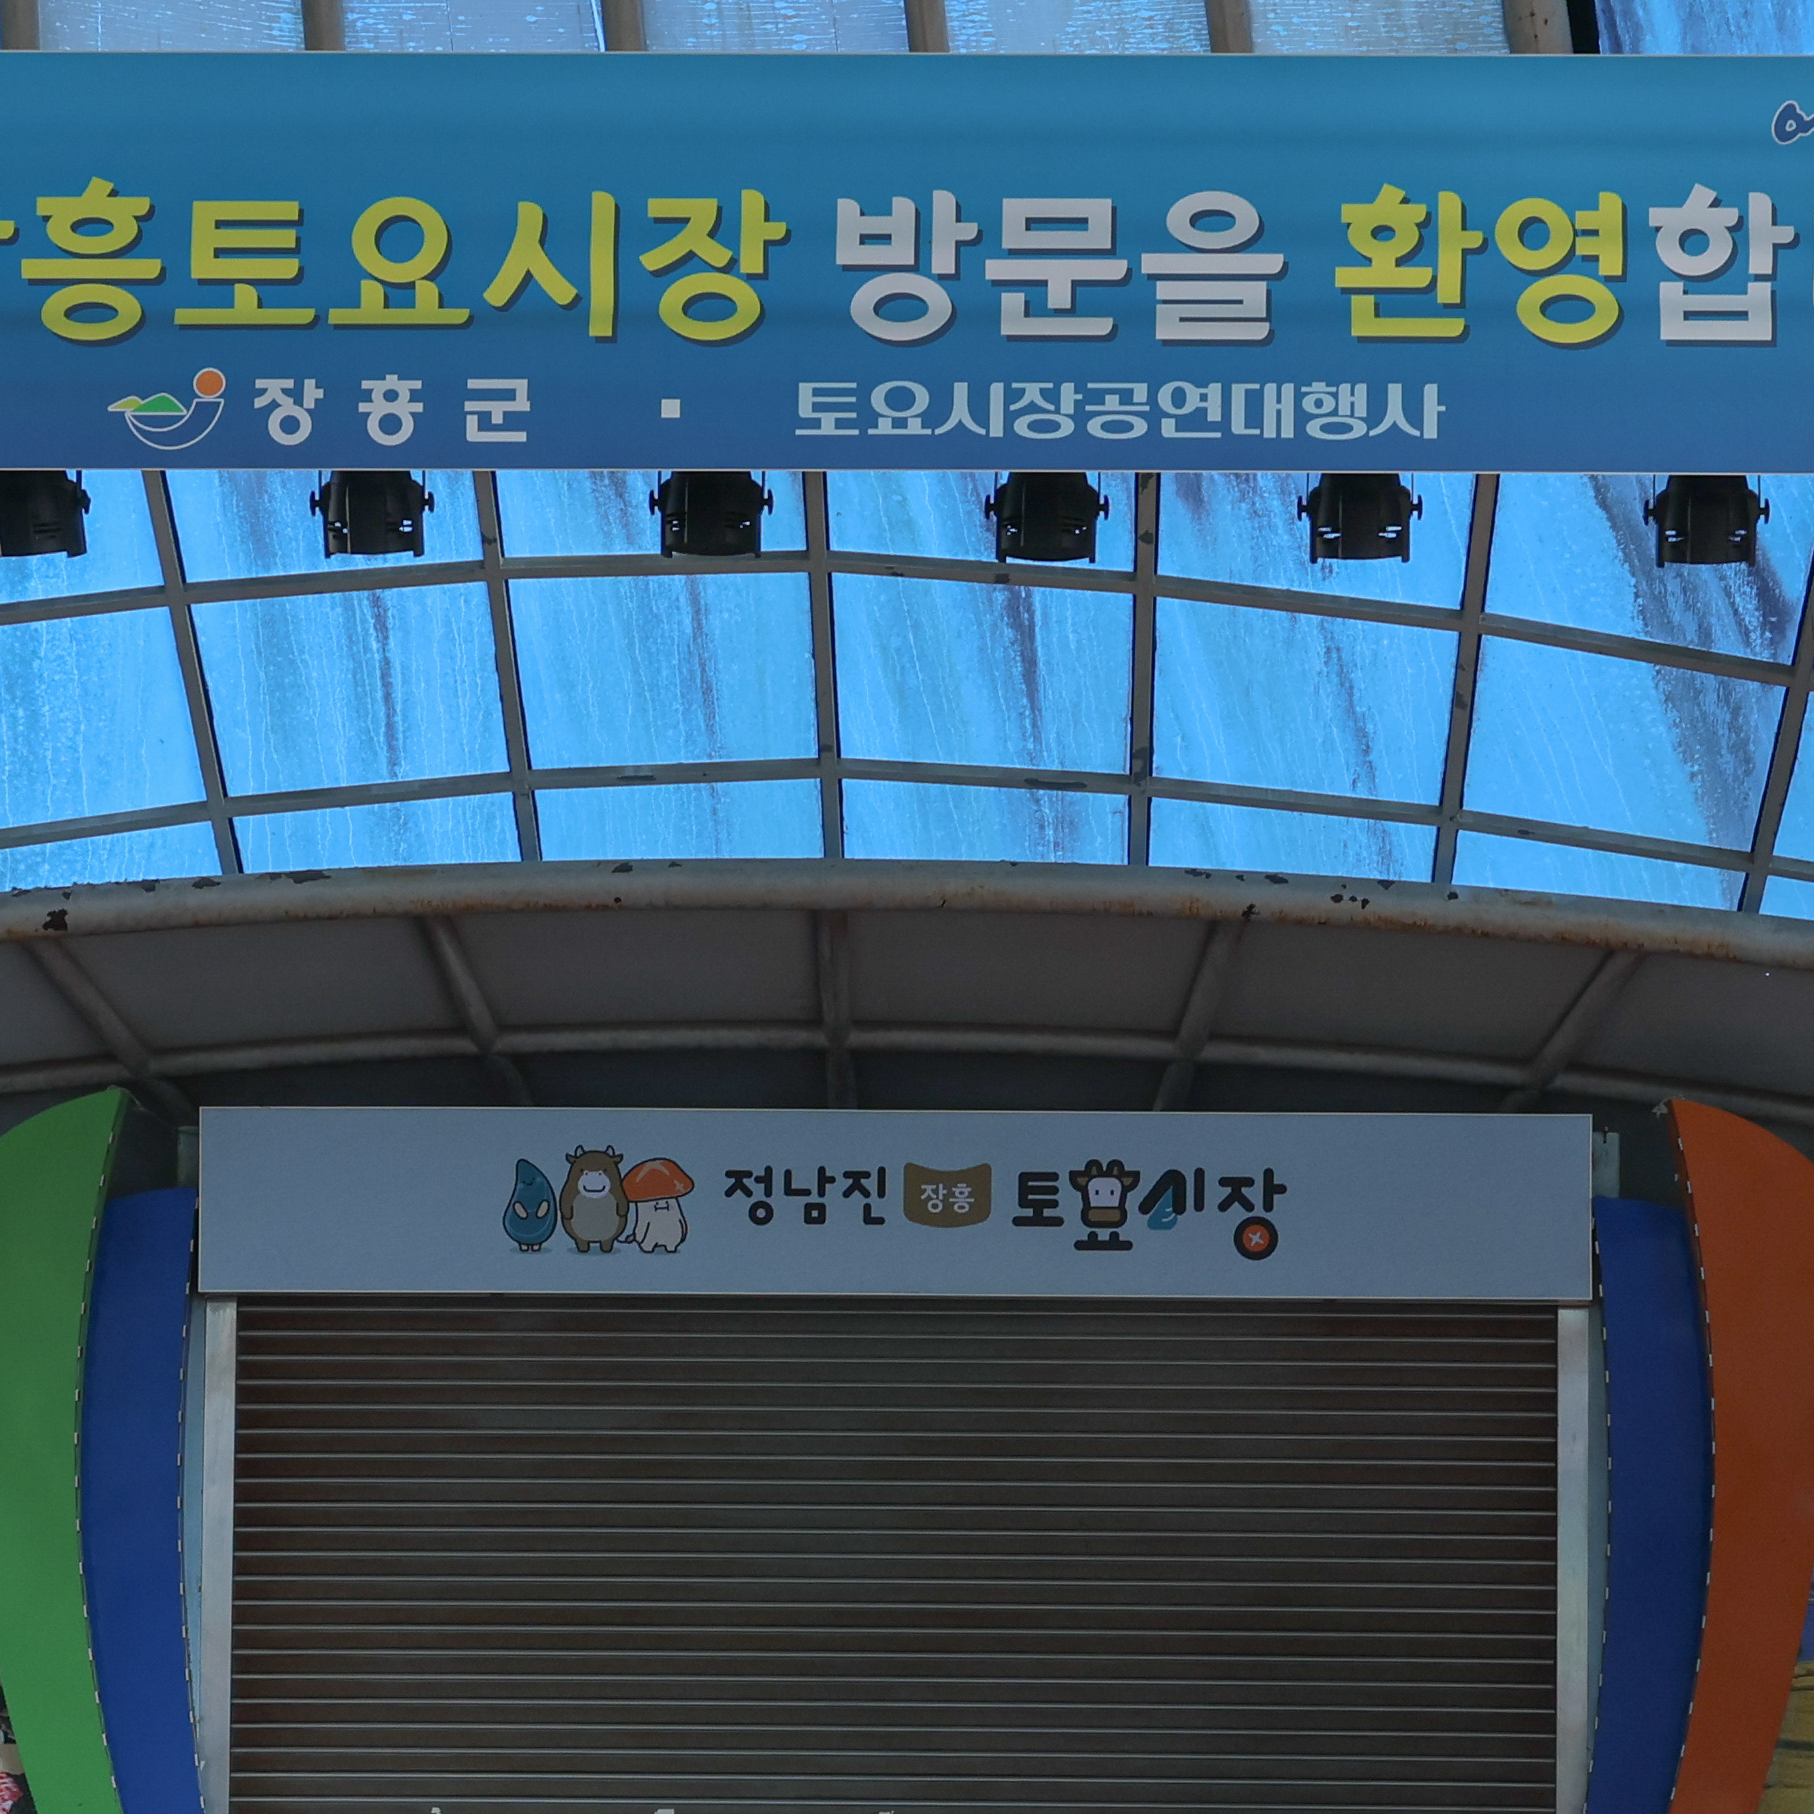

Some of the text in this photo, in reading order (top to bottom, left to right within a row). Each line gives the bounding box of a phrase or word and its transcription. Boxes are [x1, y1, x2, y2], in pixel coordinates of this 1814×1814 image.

[835, 190, 1286, 344] 방문을
[794, 380, 1446, 441] 토요시장공연대행사
[724, 1165, 888, 1228] 정남진
[919, 1180, 976, 1214] 장흥
